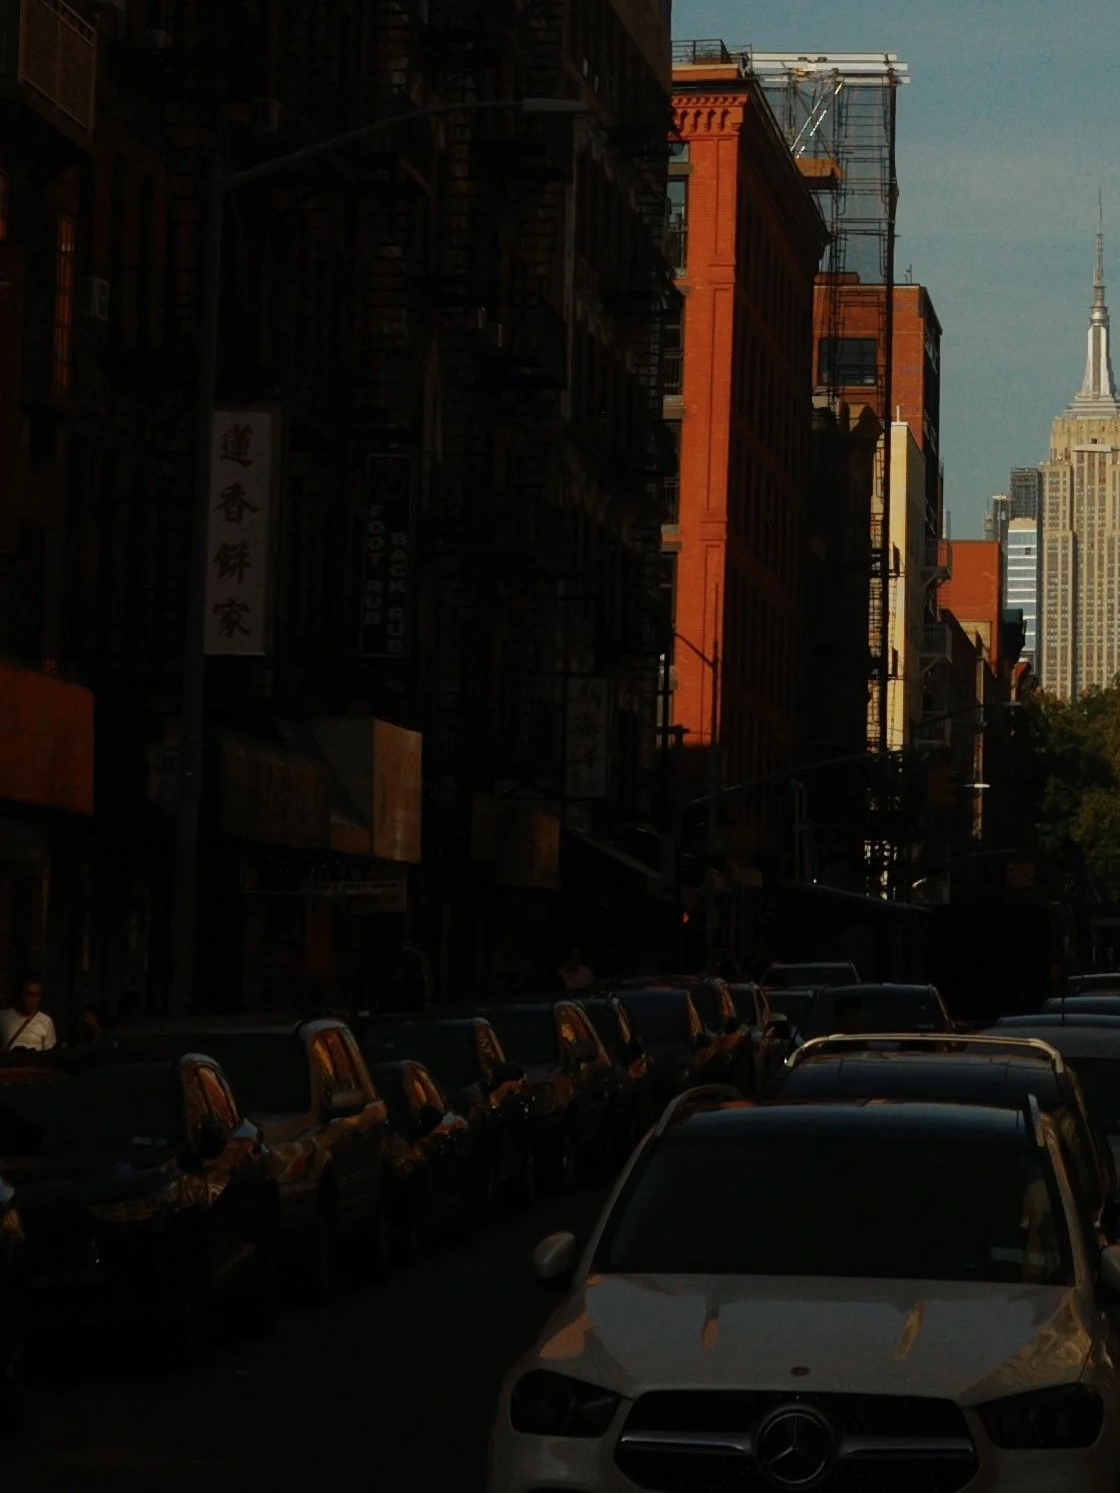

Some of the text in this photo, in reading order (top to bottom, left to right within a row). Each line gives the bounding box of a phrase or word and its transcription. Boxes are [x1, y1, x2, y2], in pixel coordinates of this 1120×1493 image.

[365, 579, 383, 625] RUB
[386, 531, 407, 653] BACK RUB
